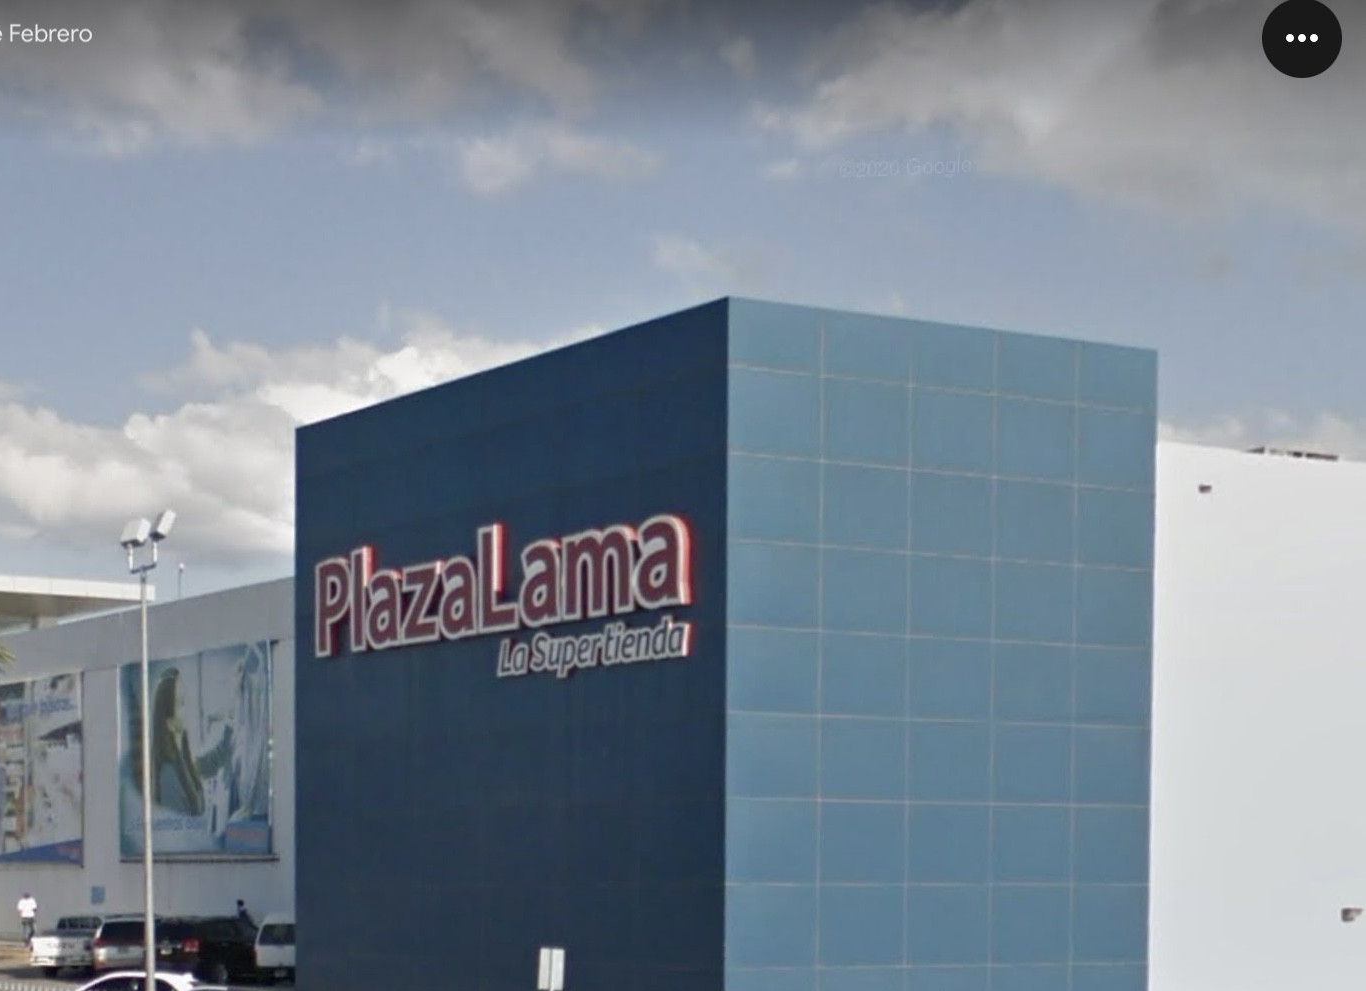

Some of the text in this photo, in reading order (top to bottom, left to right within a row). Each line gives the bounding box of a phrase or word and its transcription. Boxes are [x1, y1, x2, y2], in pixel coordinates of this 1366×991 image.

[314, 514, 691, 658] PlazaLama
[497, 615, 691, 679] La Supertienda
